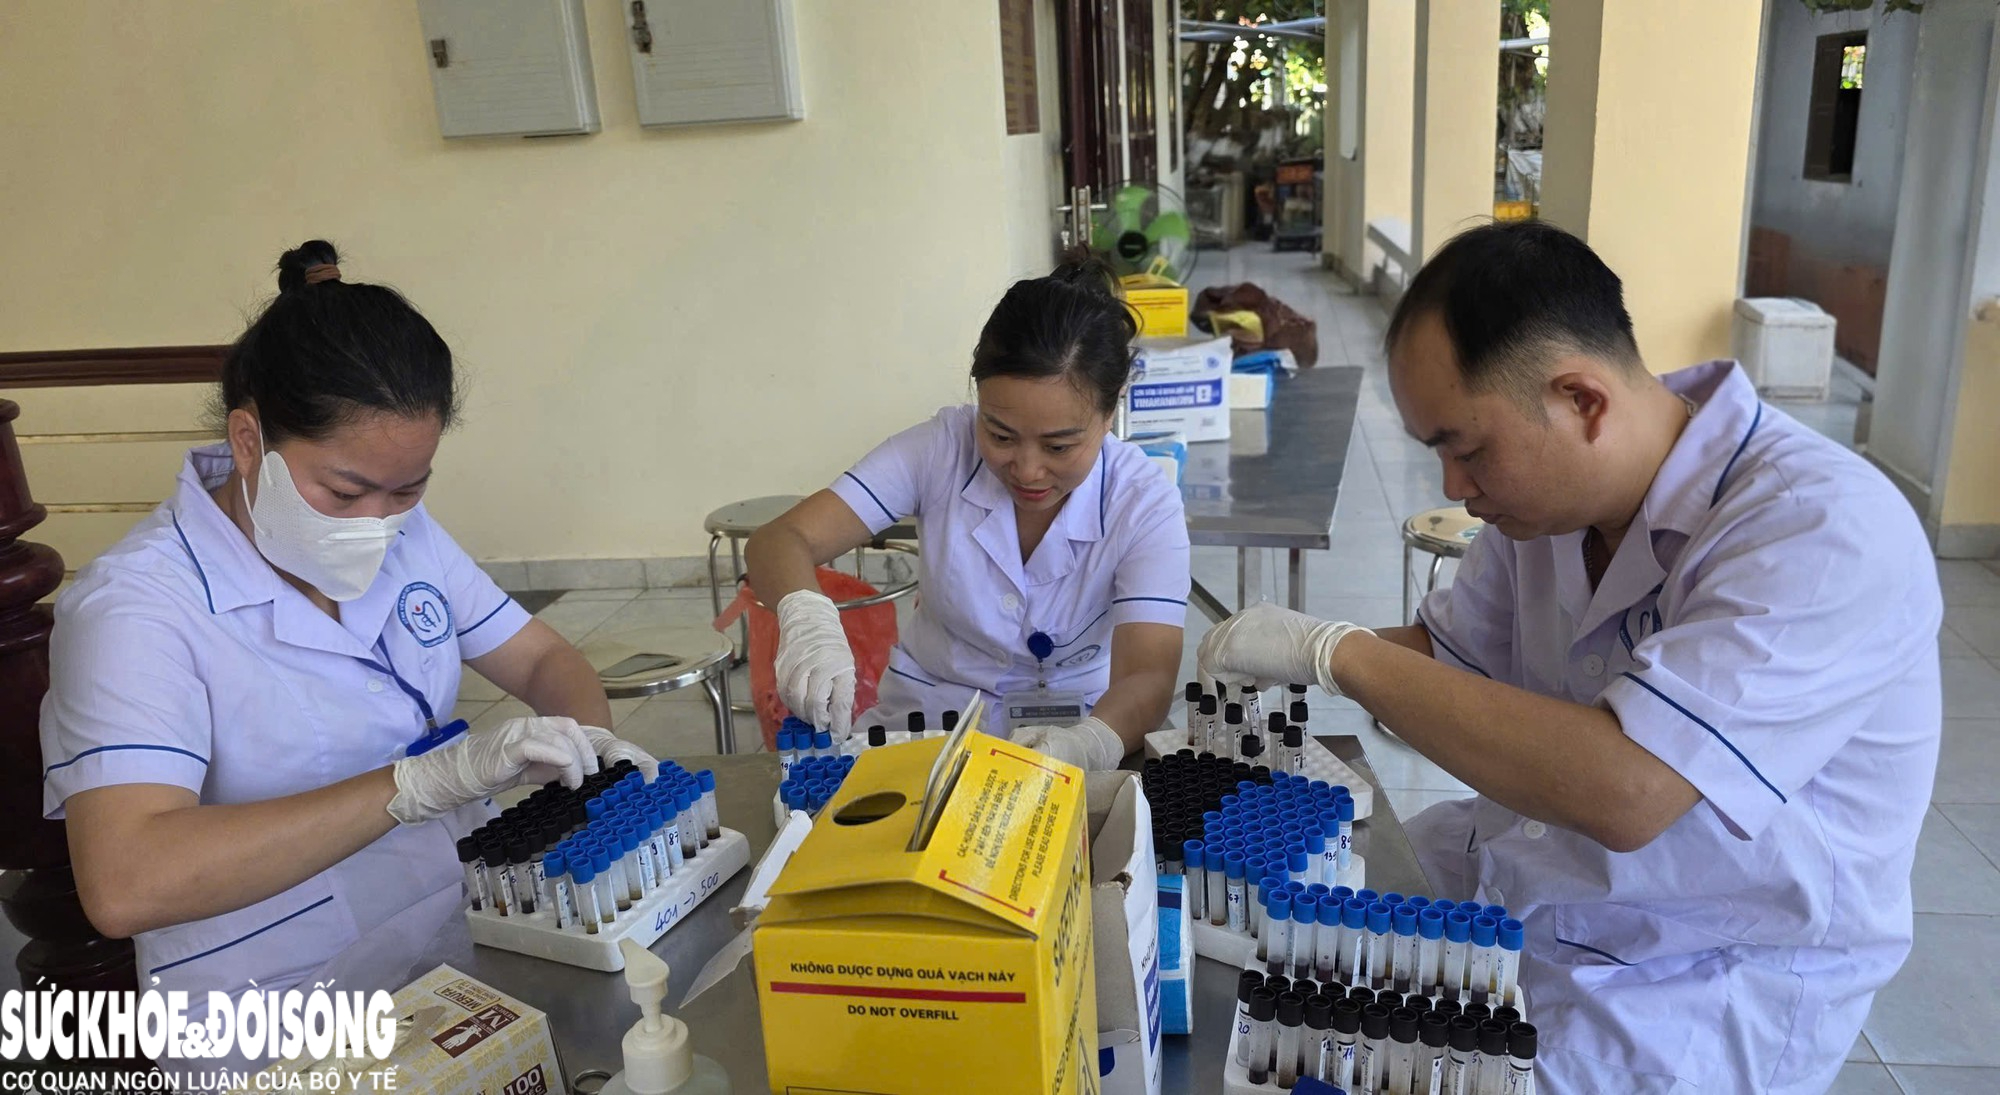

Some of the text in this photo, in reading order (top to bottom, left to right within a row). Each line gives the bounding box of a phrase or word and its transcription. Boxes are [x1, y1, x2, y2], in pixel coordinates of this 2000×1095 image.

[1037, 805, 1044, 814] ON
[1029, 813, 1042, 837] PRINTED
[1025, 836, 1035, 849] USE
[1032, 801, 1059, 877] PLEASE READ BEFORE USE
[1021, 849, 1031, 863] FOR
[1009, 862, 1028, 901] DIRECTIONS
[655, 872, 719, 932] 401 500
[790, 961, 834, 974] KHÔNG
[837, 964, 873, 978] ĐƯỢC
[948, 970, 985, 984] VẠCH
[441, 987, 482, 1010] MERUFA
[848, 1005, 959, 1020] DO NOT OVERFILL
[506, 1068, 541, 1095] 100
